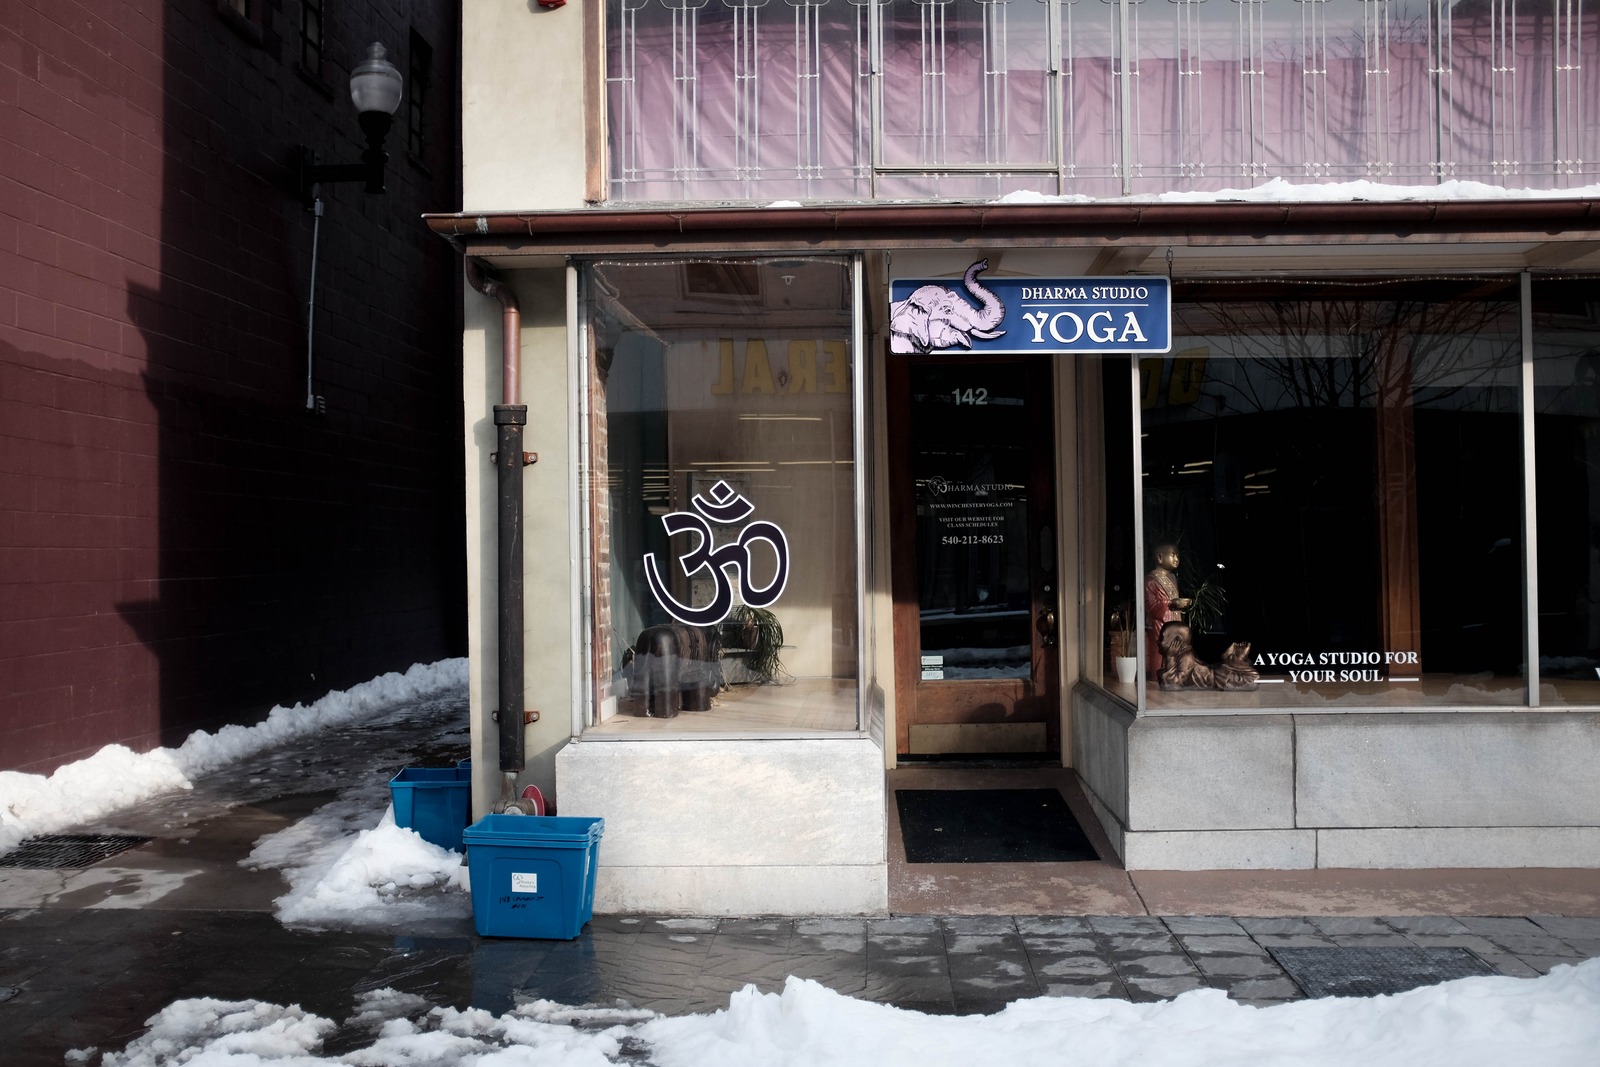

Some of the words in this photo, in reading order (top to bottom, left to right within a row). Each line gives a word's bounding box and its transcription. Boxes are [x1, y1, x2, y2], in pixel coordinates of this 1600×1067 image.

[1021, 287, 1088, 300] DHARMA
[1091, 286, 1149, 300] STUDIO
[1021, 310, 1149, 344] YOGA
[951, 387, 988, 406] 142
[981, 483, 1014, 491] STUDIO
[941, 534, 1004, 545] 540-212-8623
[1254, 653, 1265, 666] A
[1268, 652, 1315, 666] YOGA
[1319, 652, 1381, 666] STUDIO
[1385, 651, 1419, 665] FOR
[1288, 669, 1337, 684] YOUR
[1340, 669, 1384, 683] SOUL
